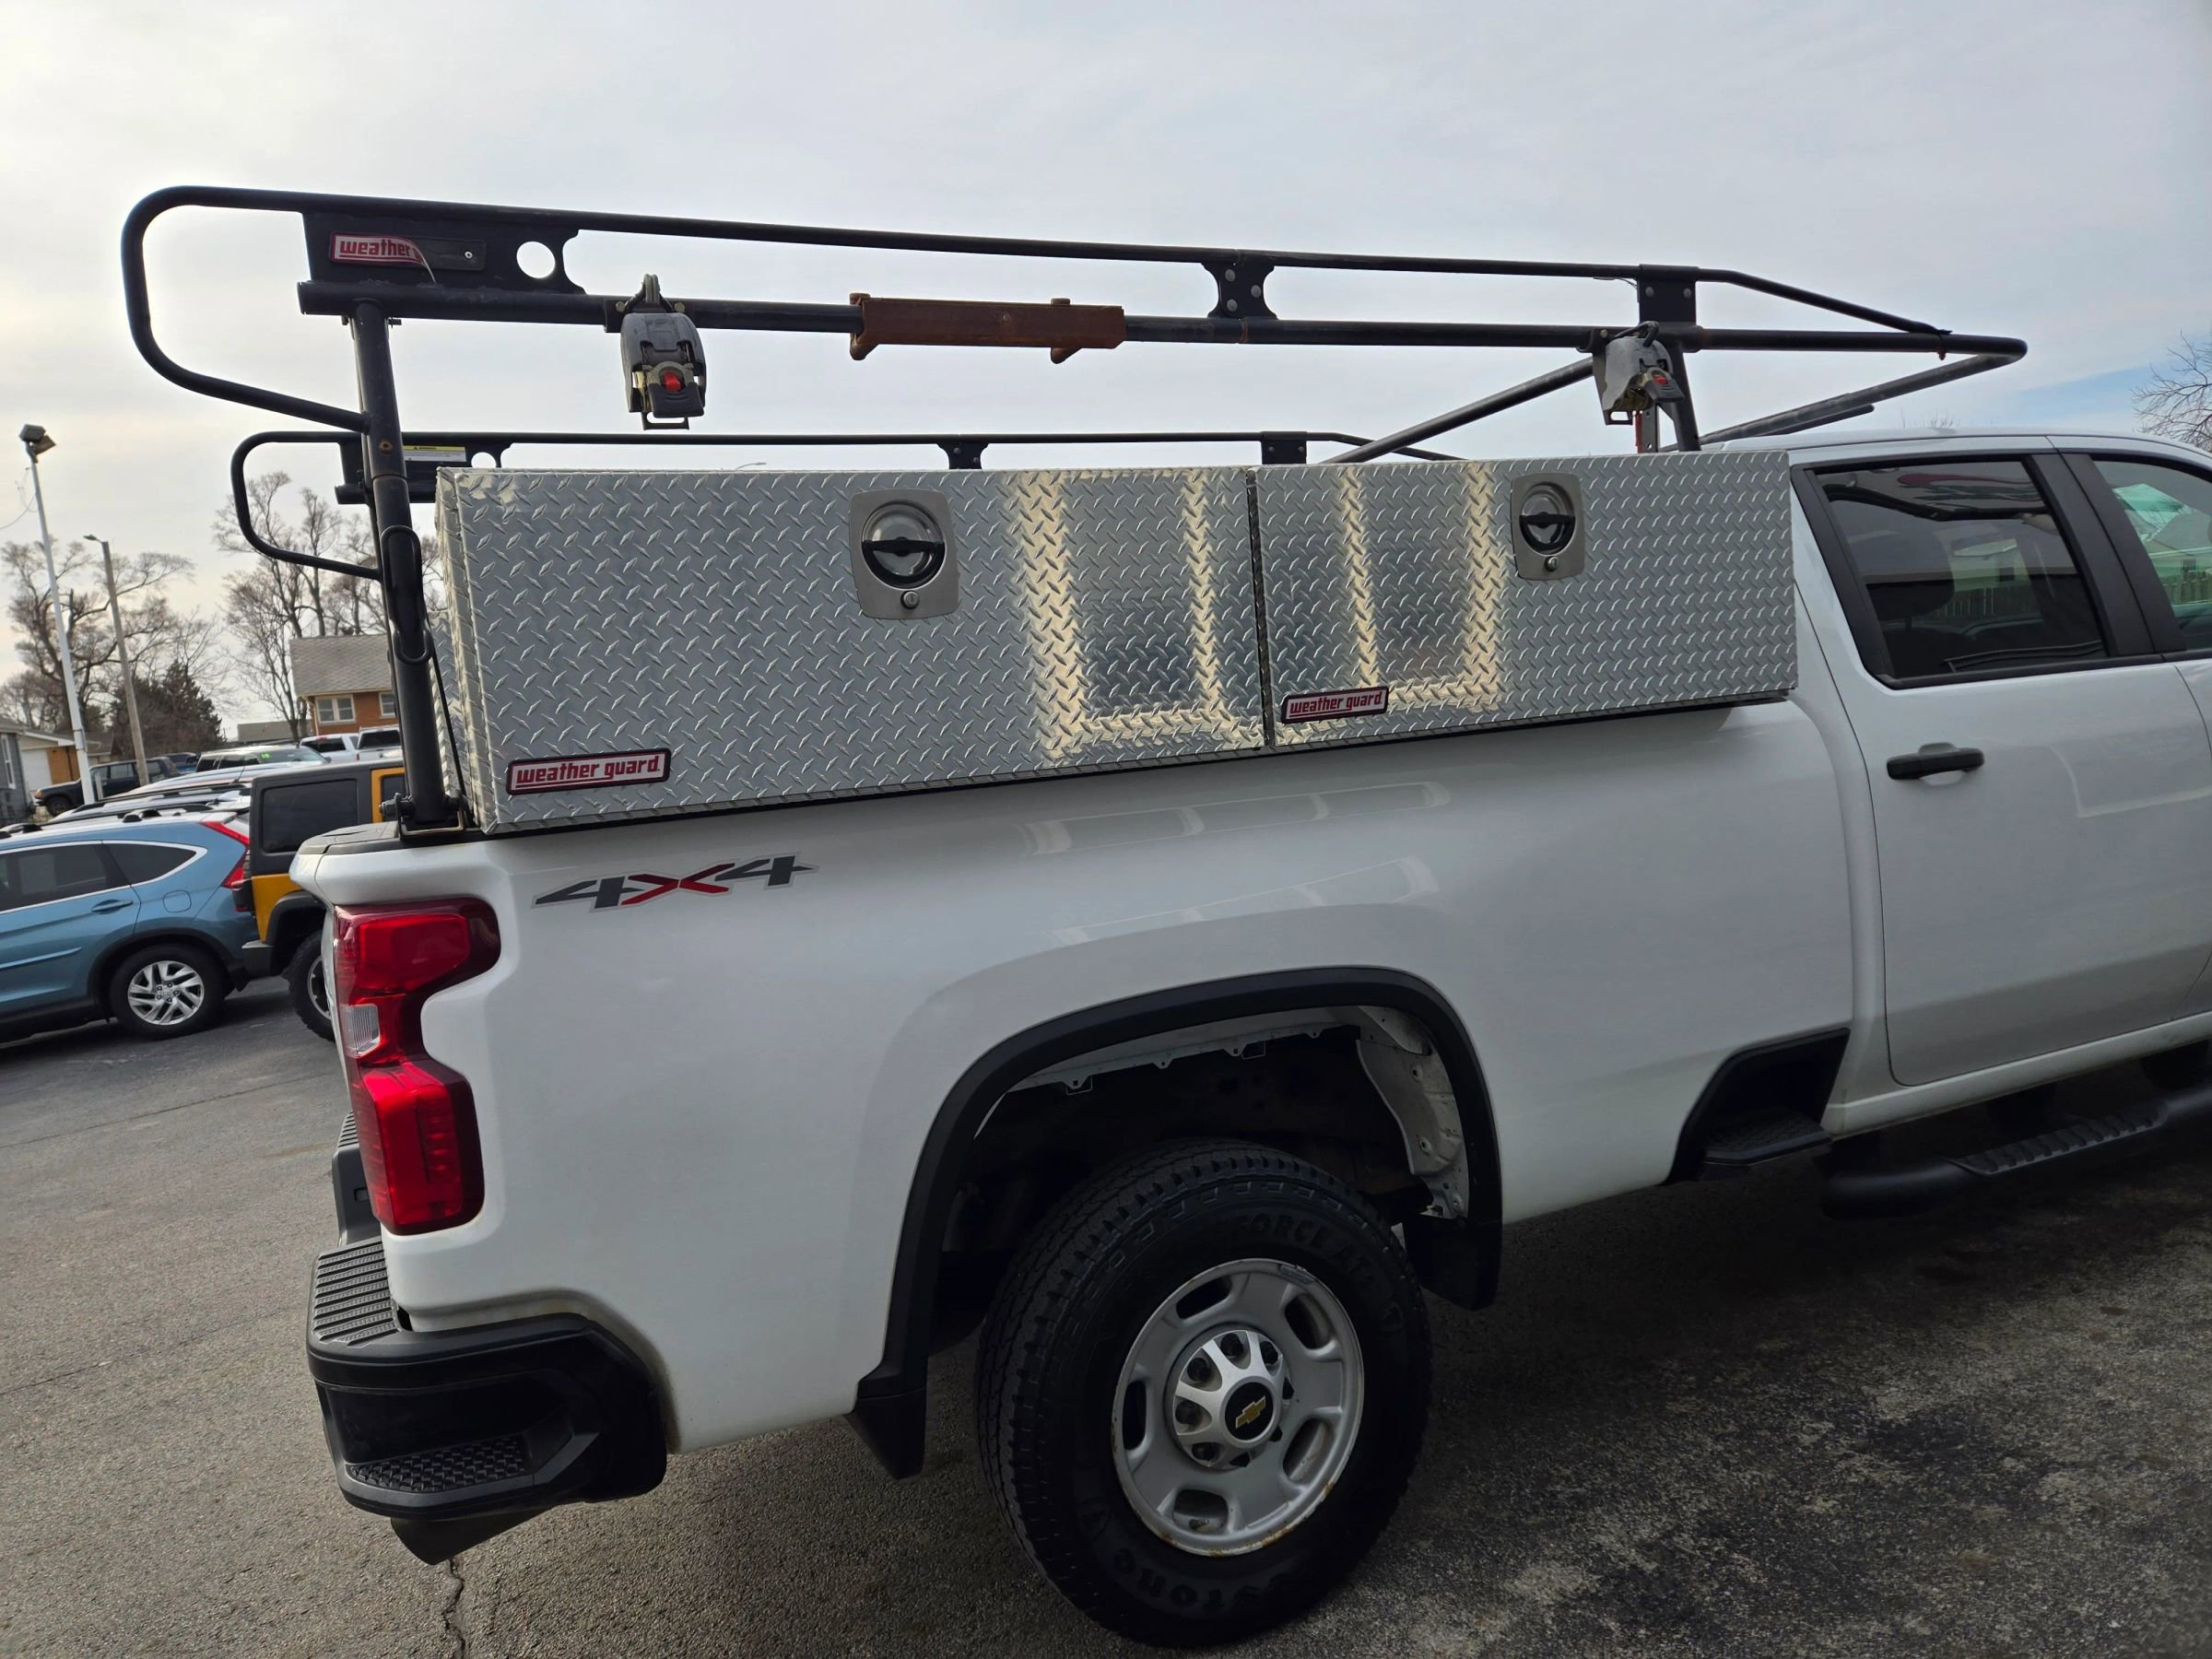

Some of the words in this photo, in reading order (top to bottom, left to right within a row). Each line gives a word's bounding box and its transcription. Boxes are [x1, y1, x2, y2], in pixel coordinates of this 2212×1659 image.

[339, 239, 410, 257] weather
[1289, 697, 1344, 714] weather
[1346, 690, 1382, 712] guard
[516, 762, 600, 784] weather
[605, 755, 659, 780] guard
